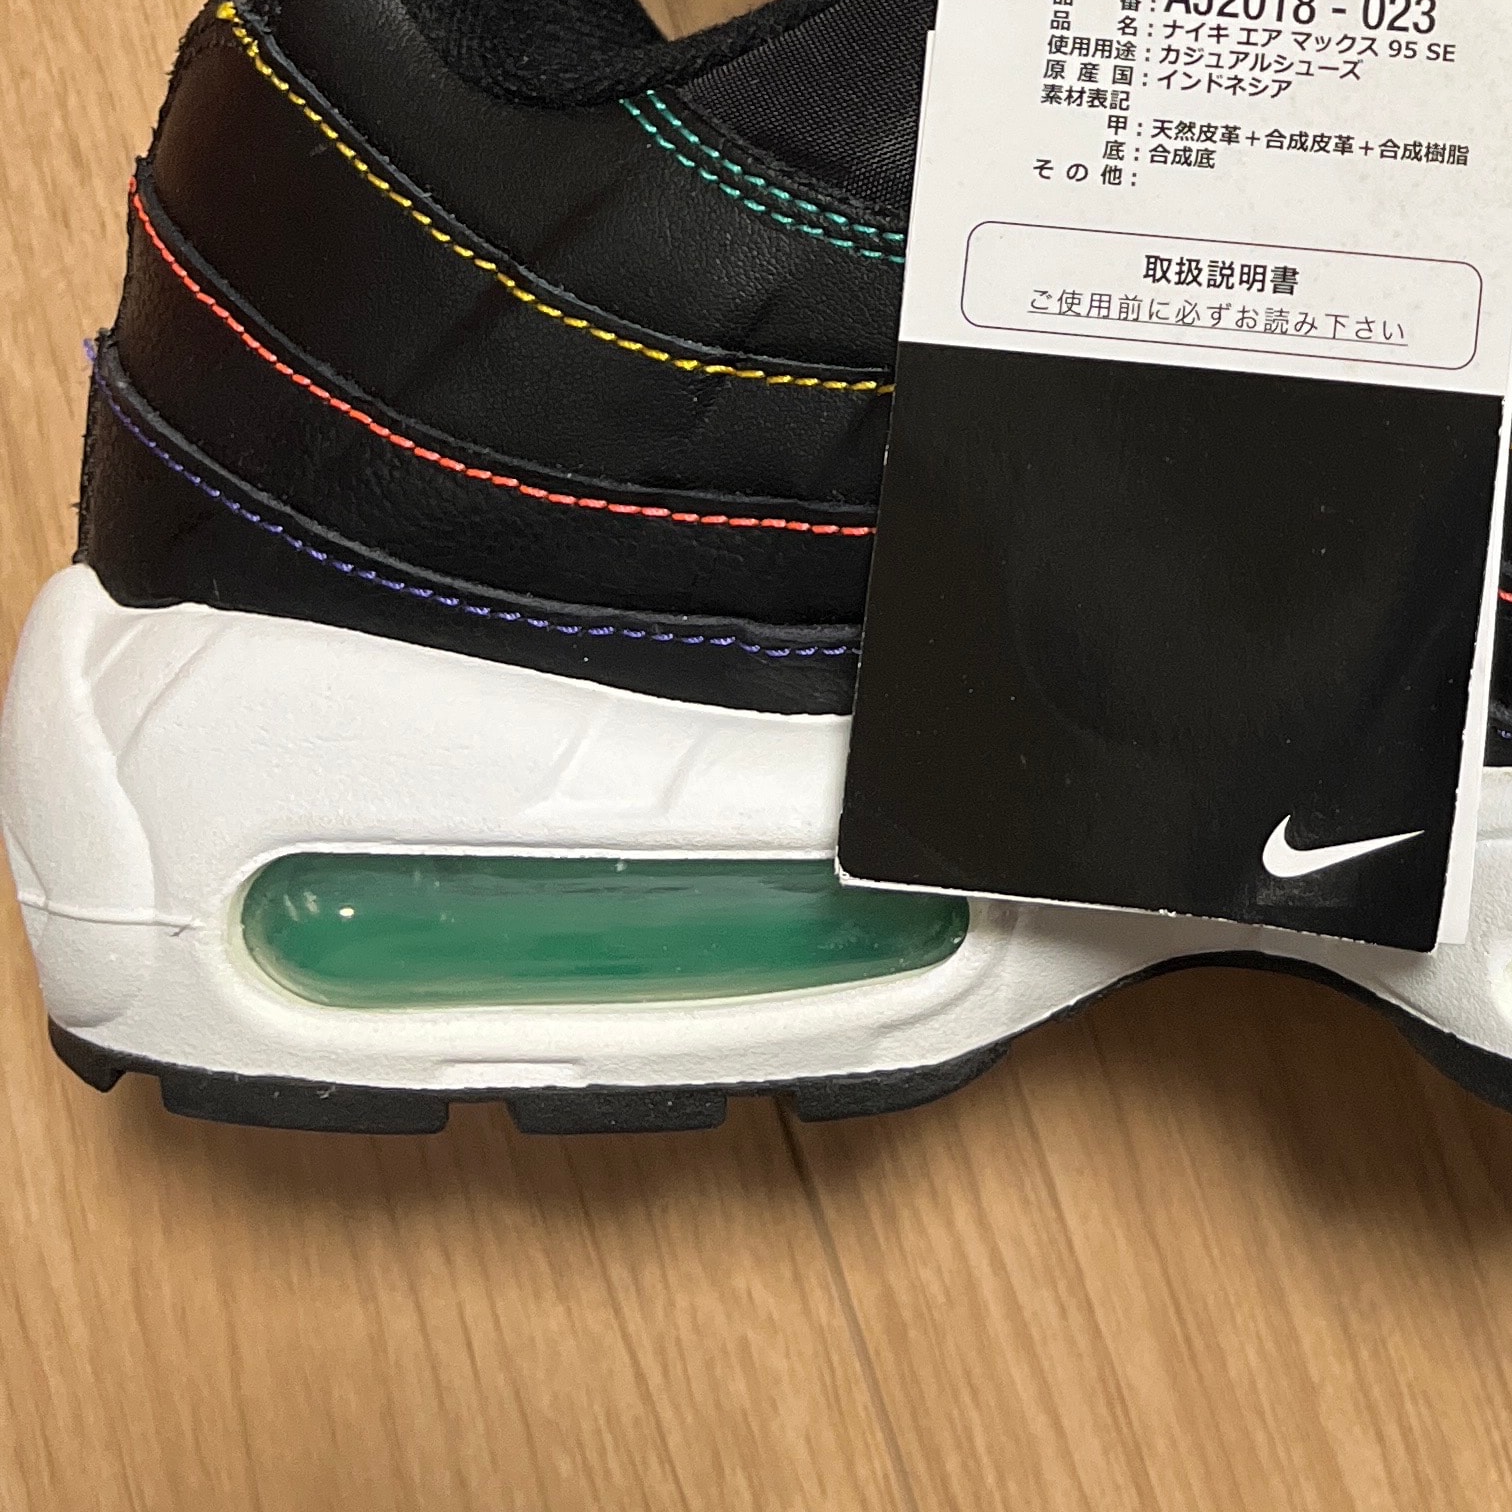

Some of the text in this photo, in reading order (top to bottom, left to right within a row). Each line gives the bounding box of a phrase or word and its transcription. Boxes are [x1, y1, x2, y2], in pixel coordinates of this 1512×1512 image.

[1159, 44, 1364, 81] カジュアルシューズ
[1388, 39, 1418, 59] 95
[1426, 42, 1456, 62] SE
[1040, 83, 1130, 111] 素材表記
[1157, 69, 1292, 99] インドネシア
[1148, 143, 1217, 169] 合成底
[1142, 254, 1301, 296] 取扱説明書
[1029, 289, 1405, 342] ご使用前に必ずお読み下さい
